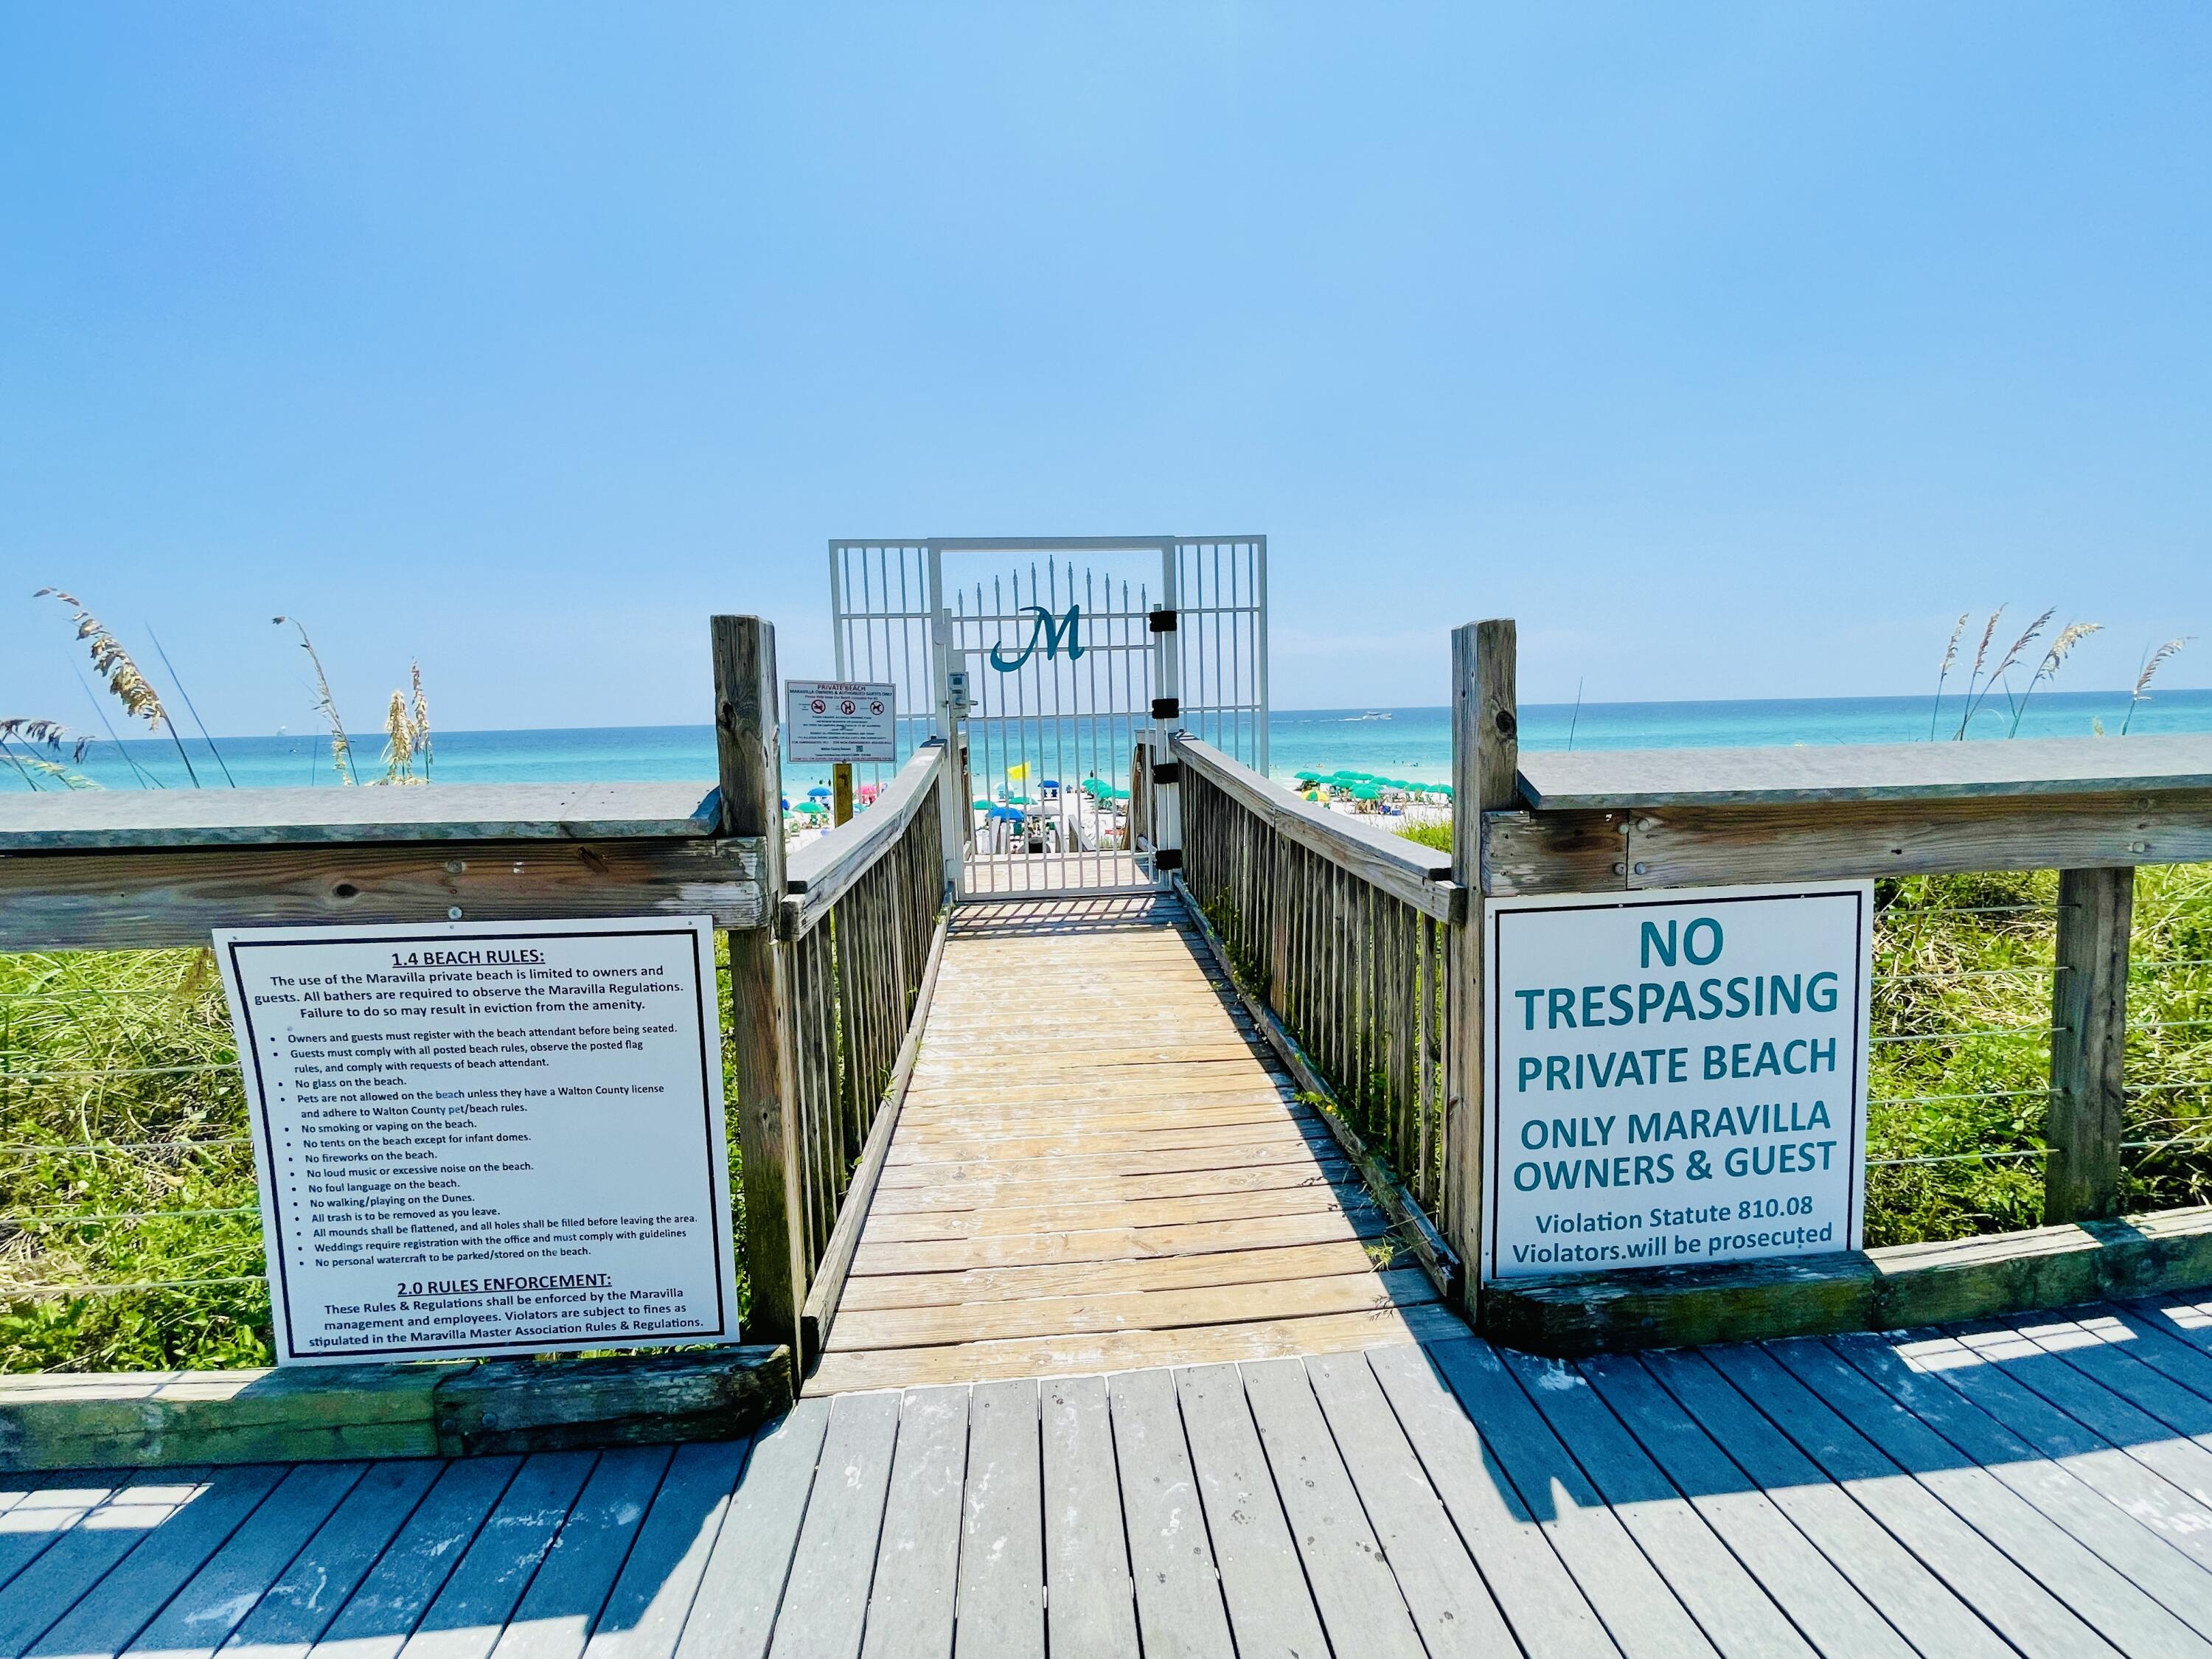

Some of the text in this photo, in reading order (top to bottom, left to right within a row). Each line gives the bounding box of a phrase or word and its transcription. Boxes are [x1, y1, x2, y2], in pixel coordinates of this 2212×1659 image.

[990, 604, 1085, 672] M
[1641, 917, 1723, 968] NO
[392, 949, 544, 966] 1.4 BEACH RULES:
[269, 965, 663, 986] The use of the Maravilla private beach is limited to owners and
[254, 994, 300, 1005] guests.
[304, 991, 320, 1001] All
[323, 990, 372, 1001] bathers
[399, 987, 452, 1001] required
[456, 988, 469, 997] to
[472, 987, 521, 997] observe
[524, 985, 545, 995] the
[549, 984, 605, 995] Maravilla
[609, 982, 683, 995] Regulations.
[1514, 971, 1837, 1030] TRESPASSING
[300, 1007, 343, 1018] Failure
[346, 1008, 360, 1016] to
[364, 1006, 379, 1016] do
[400, 1007, 427, 1017] may
[431, 1004, 466, 1014] result
[468, 1004, 480, 1013] in
[484, 1002, 532, 1013] eviction
[535, 1001, 565, 1012] from
[568, 1001, 588, 1011] the
[592, 999, 644, 1011] amenity.
[288, 1034, 327, 1043] Owners
[330, 1032, 348, 1042] and
[351, 1032, 383, 1043] guests
[413, 1030, 451, 1041] register
[453, 1029, 475, 1038] with
[477, 1029, 494, 1037] the
[496, 1028, 526, 1037] beach
[529, 1026, 576, 1037] attendant
[578, 1026, 610, 1035] before
[613, 1025, 639, 1035] being
[642, 1023, 677, 1033] seated.
[290, 1049, 325, 1058] Guests
[355, 1046, 391, 1057] comply
[393, 1046, 416, 1055] with
[419, 1046, 430, 1054] all
[433, 1044, 466, 1056] posted
[468, 1043, 498, 1053] beach
[501, 1043, 527, 1053] rules,
[530, 1042, 568, 1051] observe
[571, 1041, 587, 1050] the
[590, 1040, 622, 1051] posted
[625, 1040, 643, 1050] flag
[294, 1057, 549, 1074] rules, and comply with requests of beach attendant.
[1518, 1037, 1835, 1092] PRIVATE BEACH
[295, 1079, 309, 1088] No
[313, 1079, 336, 1089] glass
[354, 1077, 371, 1086] the
[373, 1077, 406, 1085] beach.
[301, 1124, 316, 1133] No
[318, 1123, 360, 1133] smoking
[375, 1121, 408, 1132] vaping
[425, 1120, 442, 1129] the
[445, 1119, 476, 1128] beach.
[1521, 1100, 1830, 1150] ONLY MARAVILLA
[303, 1140, 318, 1148] No
[320, 1139, 345, 1147] tents
[363, 1137, 380, 1146] the
[382, 1135, 411, 1145] beach
[414, 1135, 446, 1145] except
[448, 1134, 462, 1143] for
[465, 1133, 493, 1142] infant
[495, 1133, 531, 1141] domes.
[305, 1155, 319, 1163] No
[321, 1152, 368, 1162] fireworks
[386, 1151, 403, 1160] the
[405, 1150, 437, 1159] beach.
[1514, 1141, 1837, 1192] OWNERS & GUEST
[325, 1183, 344, 1192] foul
[347, 1183, 391, 1192] language
[409, 1180, 425, 1189] the
[428, 1178, 460, 1188] beach.
[310, 1199, 324, 1207] No
[327, 1196, 406, 1208] walking/playing
[422, 1194, 439, 1203] the
[442, 1194, 475, 1203] Dunes.
[1535, 1196, 1812, 1234] Violation Statute 810.08
[1674, 1234, 1700, 1254] be
[1708, 1222, 1832, 1256] prosecuted
[397, 1273, 611, 1294] 2.0 RULES ENFORCEMENT:
[309, 1318, 703, 1348] stipulated in the Maravilla Master Association Rules & Regulations.
